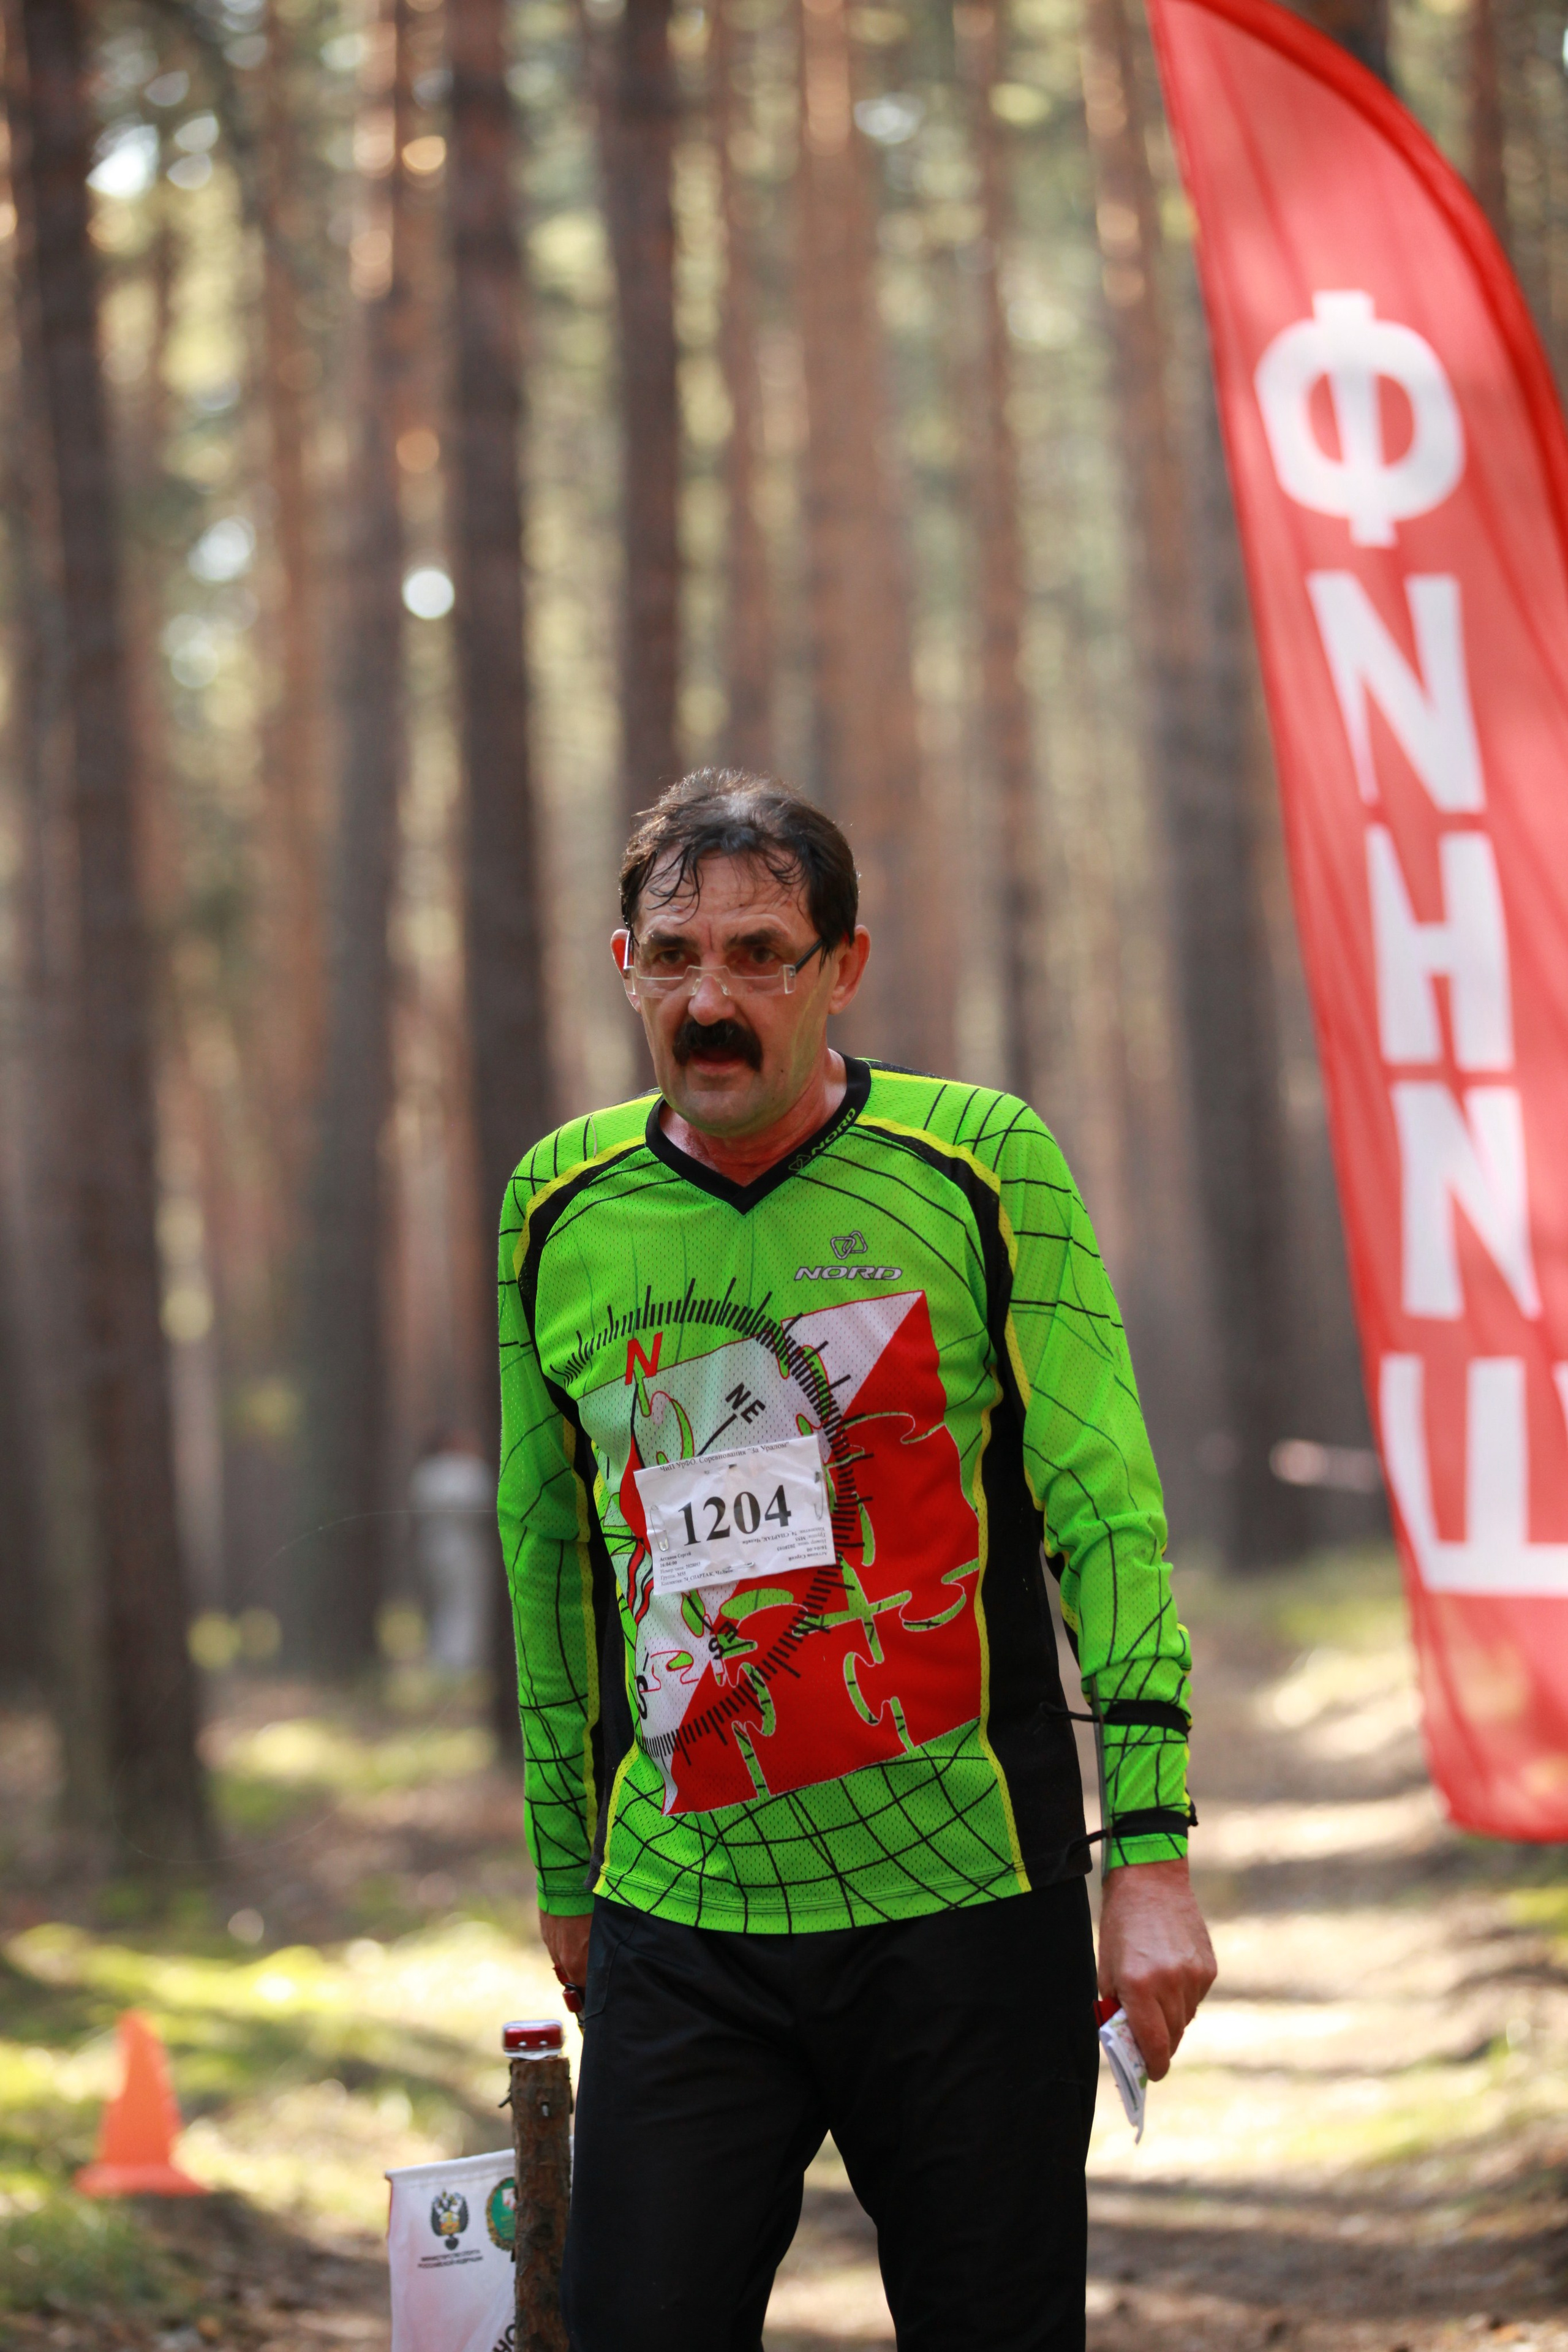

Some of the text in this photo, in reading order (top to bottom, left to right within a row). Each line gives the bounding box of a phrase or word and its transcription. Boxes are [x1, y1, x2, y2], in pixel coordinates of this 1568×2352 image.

[812, 1108, 856, 1156] NORD
[794, 1265, 903, 1280] NORD
[625, 1332, 663, 1385] N
[725, 1382, 766, 1424] NE
[676, 1458, 698, 1469] УрФО.
[699, 1450, 746, 1463] Соревнования
[760, 1441, 790, 1452] Уралом"
[678, 1485, 791, 1546] 1204
